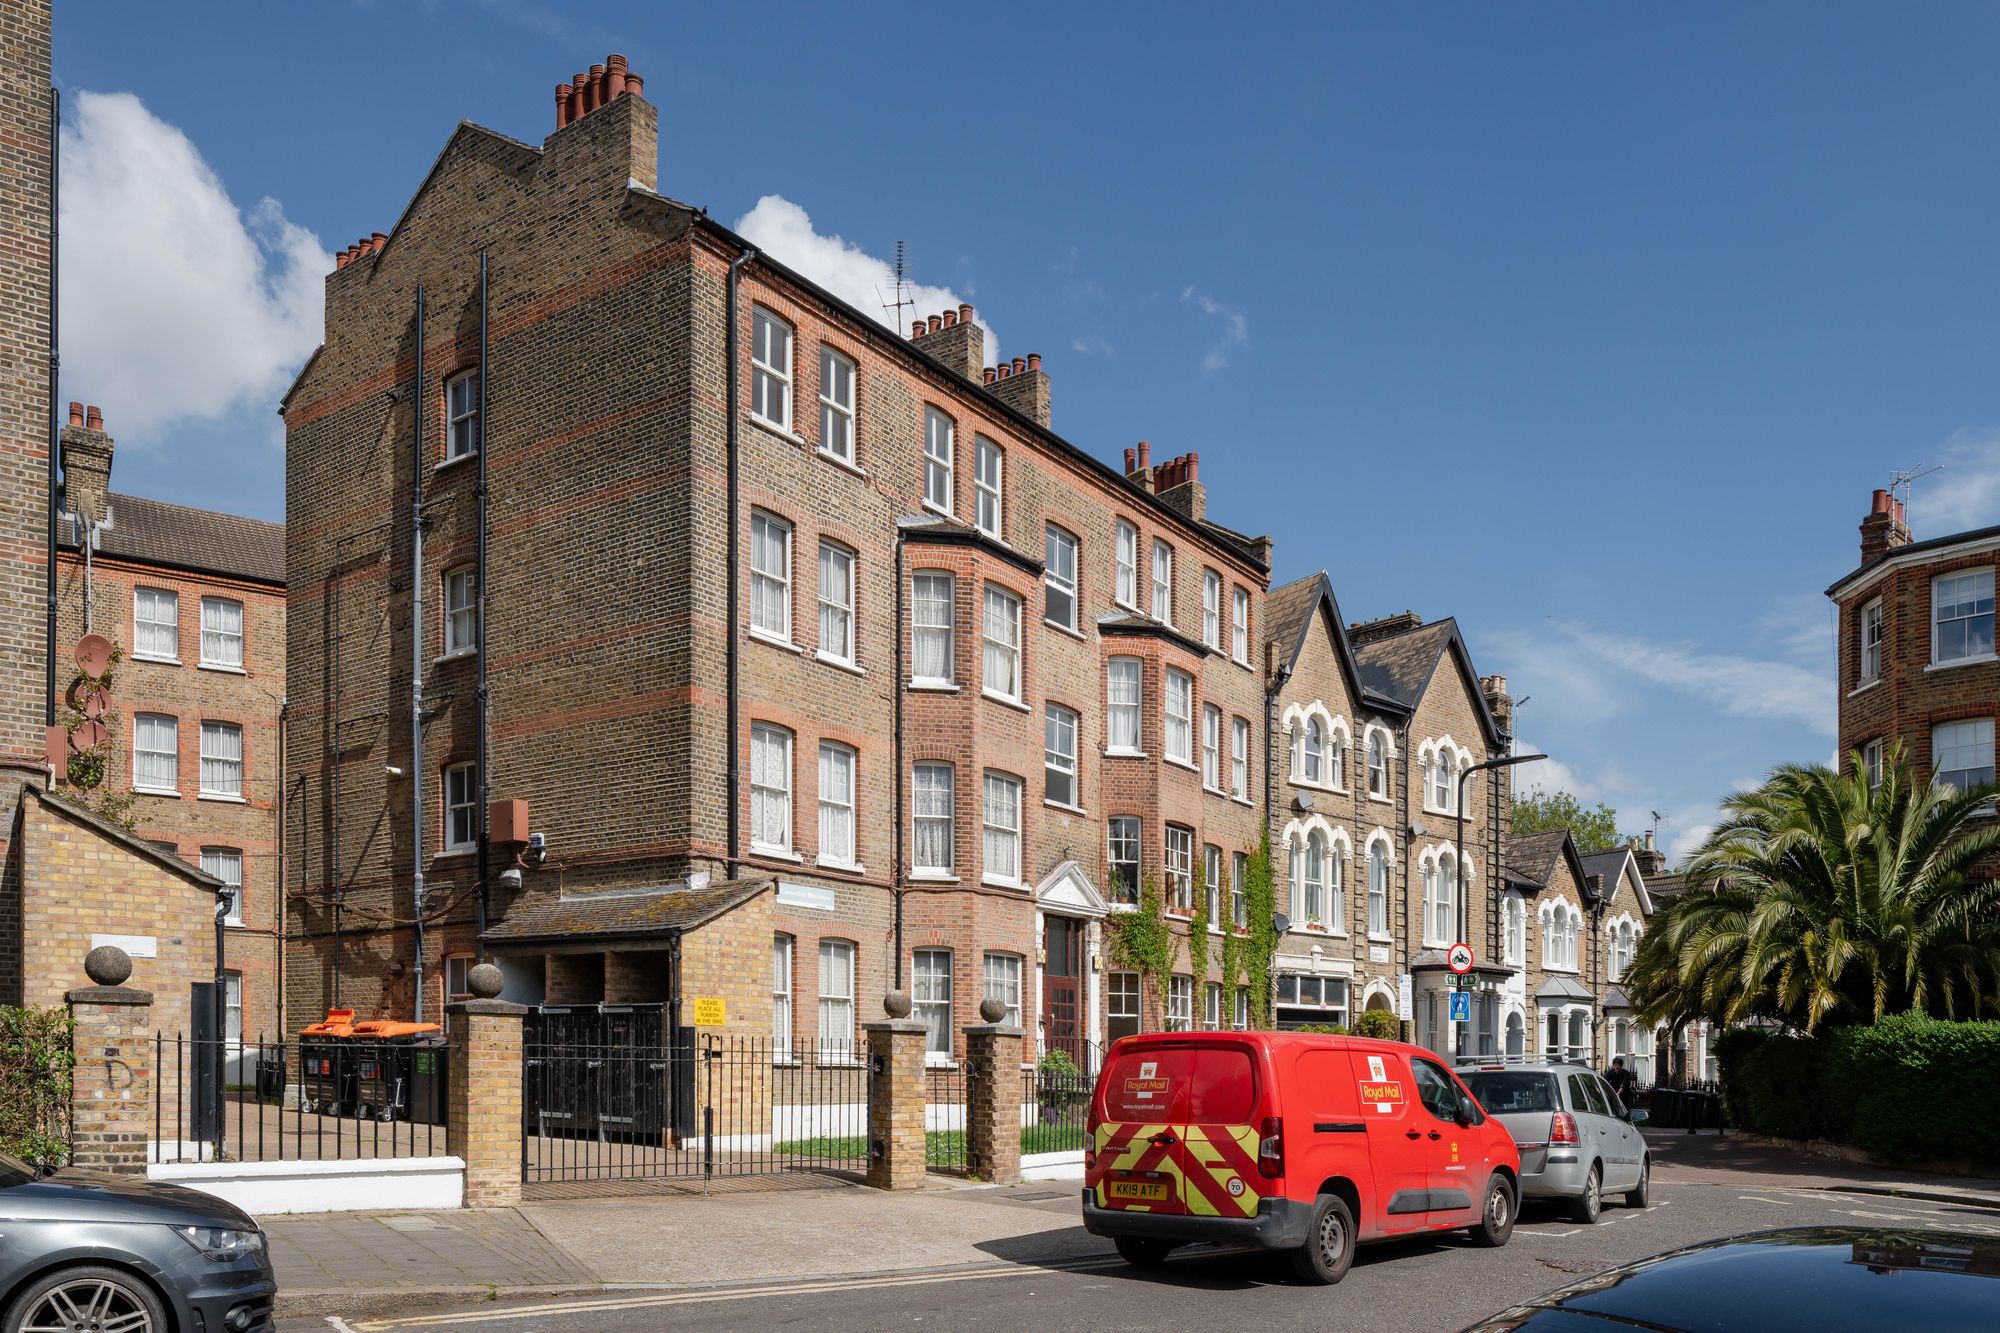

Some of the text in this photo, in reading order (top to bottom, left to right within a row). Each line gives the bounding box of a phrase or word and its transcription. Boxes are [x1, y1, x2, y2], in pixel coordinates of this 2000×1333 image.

[1128, 1081, 1148, 1091] Royal
[1363, 1085, 1400, 1100] Royal Mail
[1116, 1184, 1160, 1196] KK19 ATF
